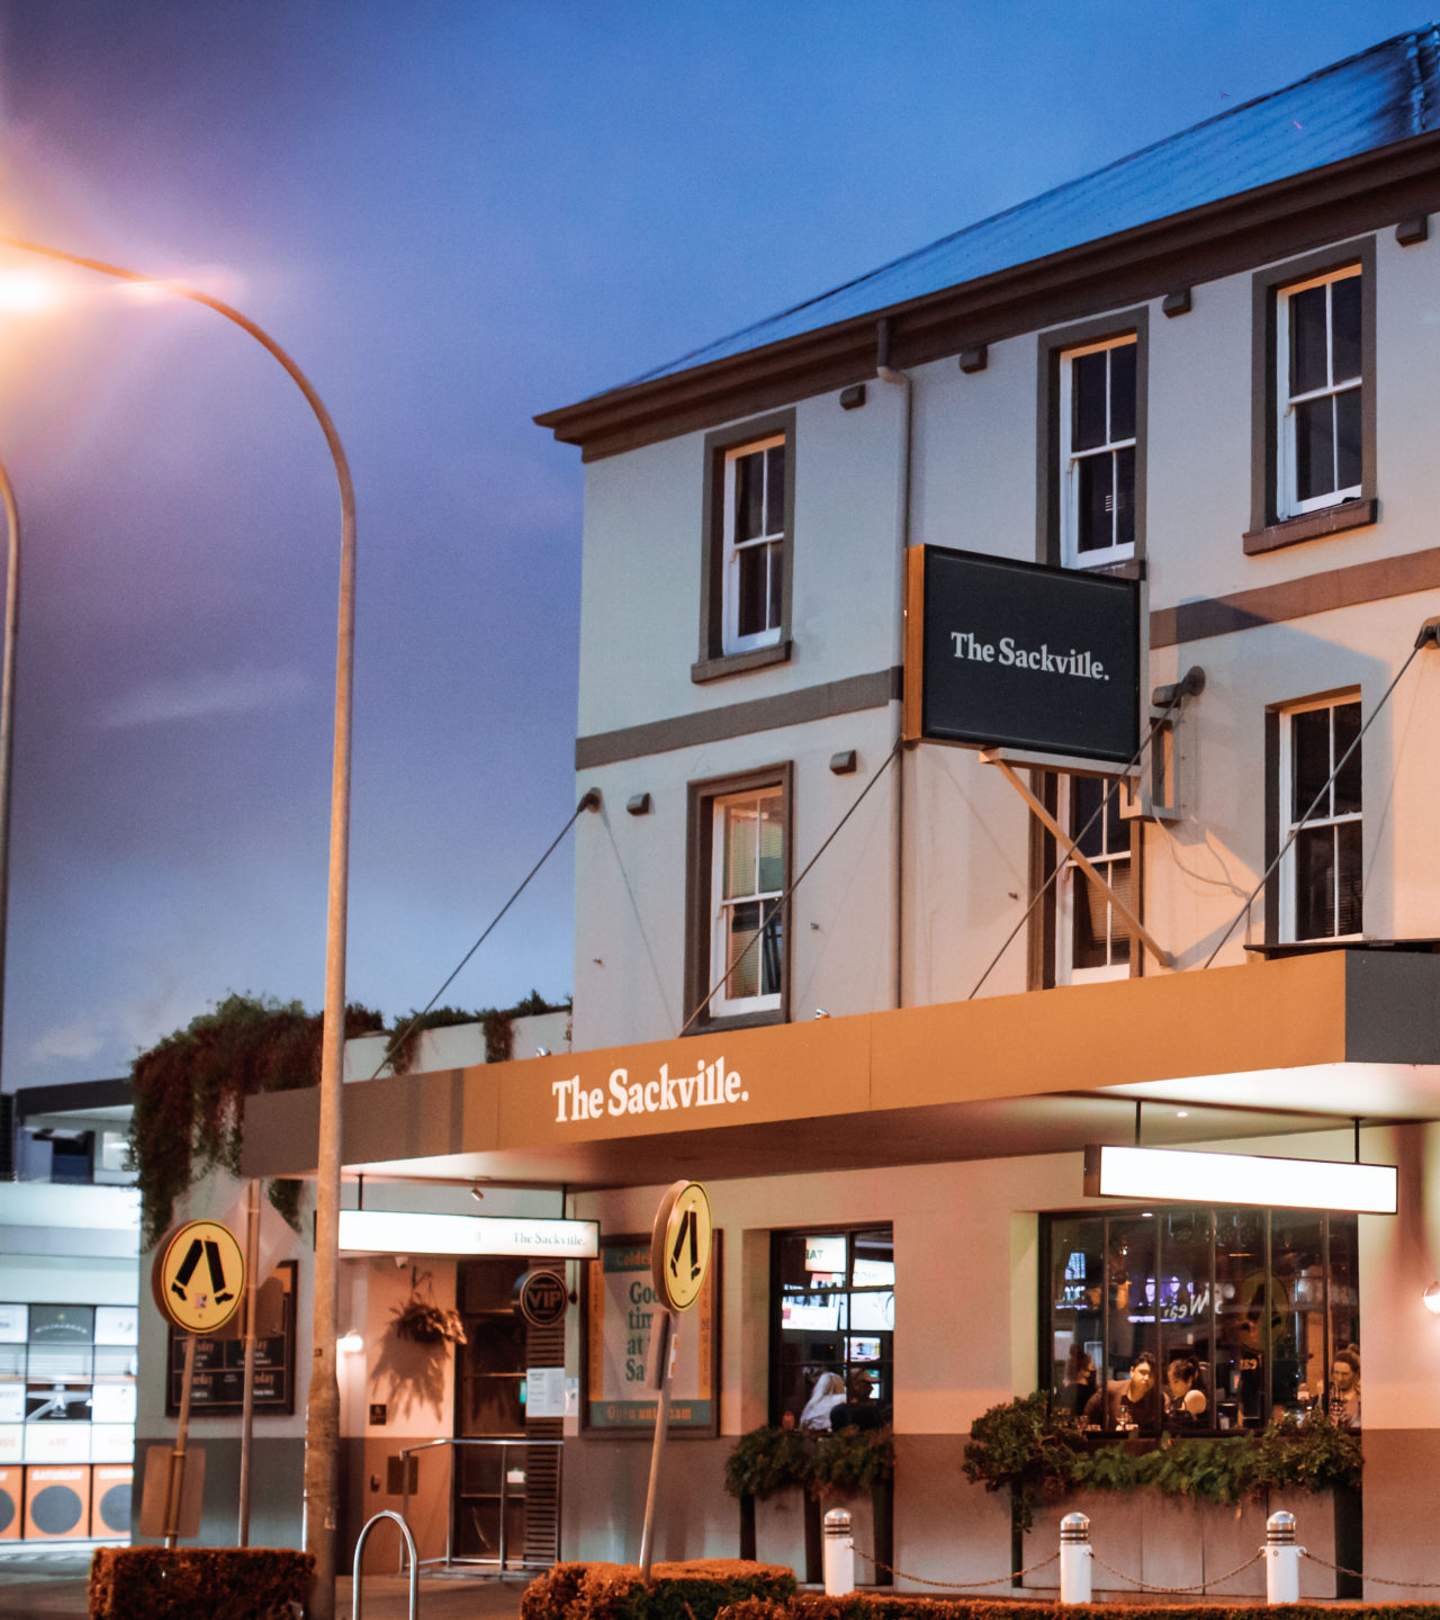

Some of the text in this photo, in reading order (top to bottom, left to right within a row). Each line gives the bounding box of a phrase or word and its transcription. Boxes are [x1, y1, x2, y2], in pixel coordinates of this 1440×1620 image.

[950, 631, 1110, 681] The Sackville.
[552, 1056, 749, 1122] The Sackville.
[527, 1290, 562, 1309] VIP
[627, 1337, 644, 1356] at
